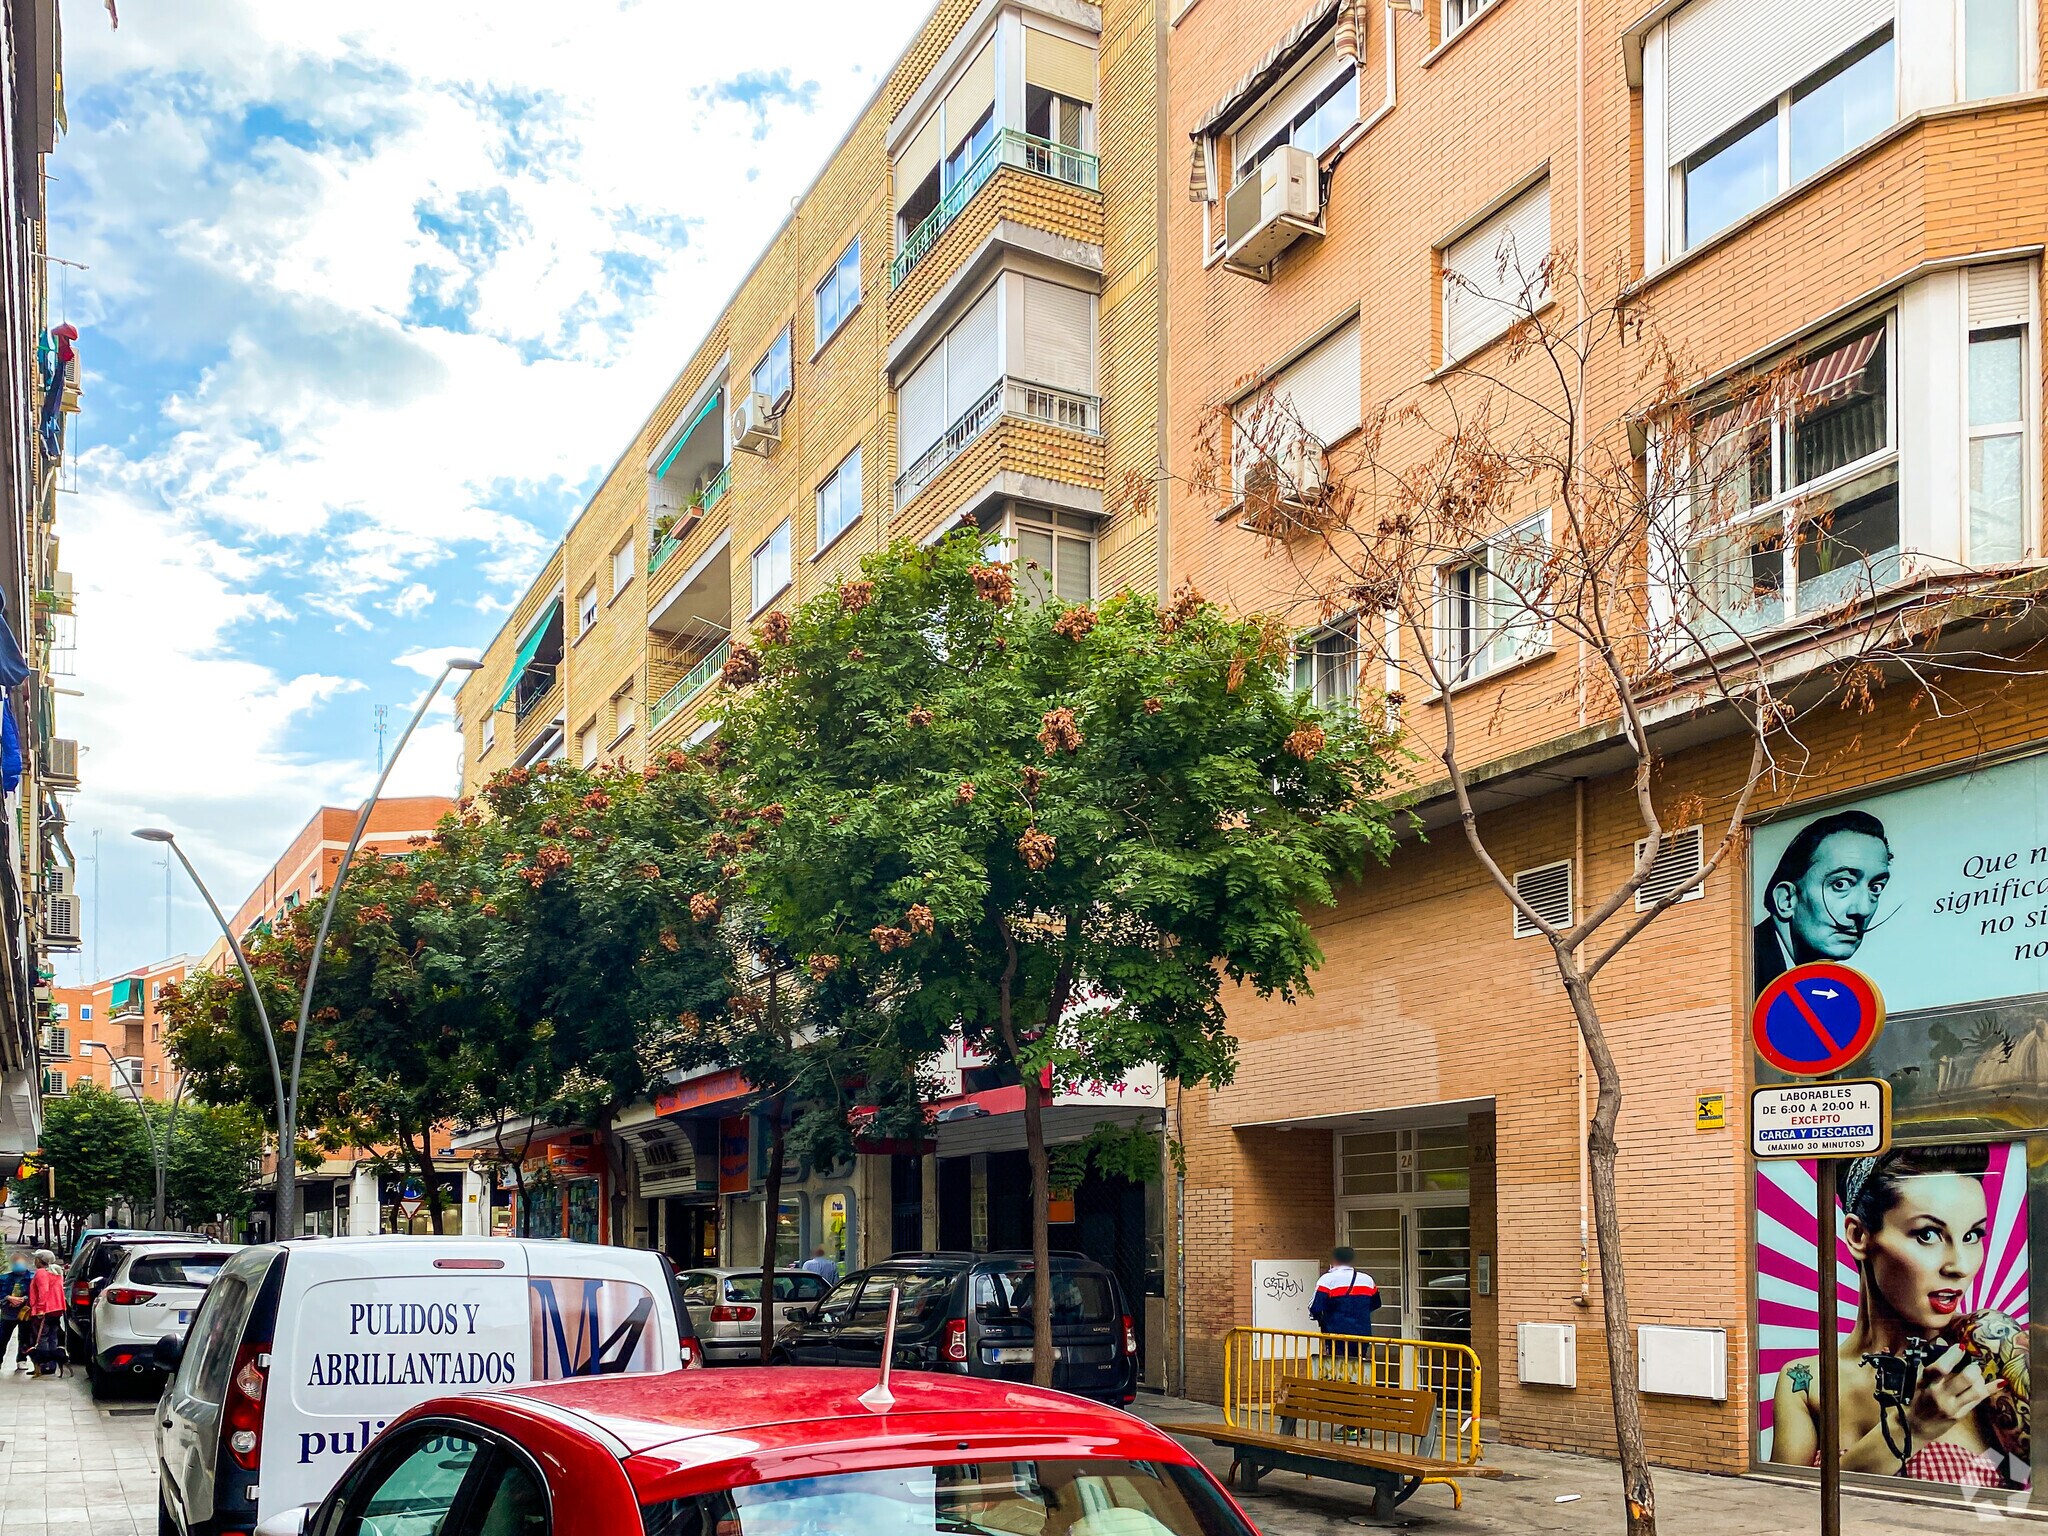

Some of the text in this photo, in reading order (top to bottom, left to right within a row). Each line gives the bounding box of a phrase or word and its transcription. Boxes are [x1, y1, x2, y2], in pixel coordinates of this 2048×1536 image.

[1963, 853, 2018, 880] Que
[1980, 915, 2014, 936] no
[2014, 941, 2048, 961] no
[1780, 1089, 1852, 1102] LABORABLES
[1762, 1101, 1870, 1115] DE 6:00 A 20:00 H.
[1791, 1114, 1841, 1125] EXCEPTO
[1760, 1126, 1872, 1140] CARGA Y DESCARGA
[1807, 1142, 1818, 1150] 30
[1822, 1140, 1865, 1150] MINUTOS)
[350, 1303, 481, 1336] PULIDOS Y
[307, 1351, 515, 1386] ABRILLANTADOS
